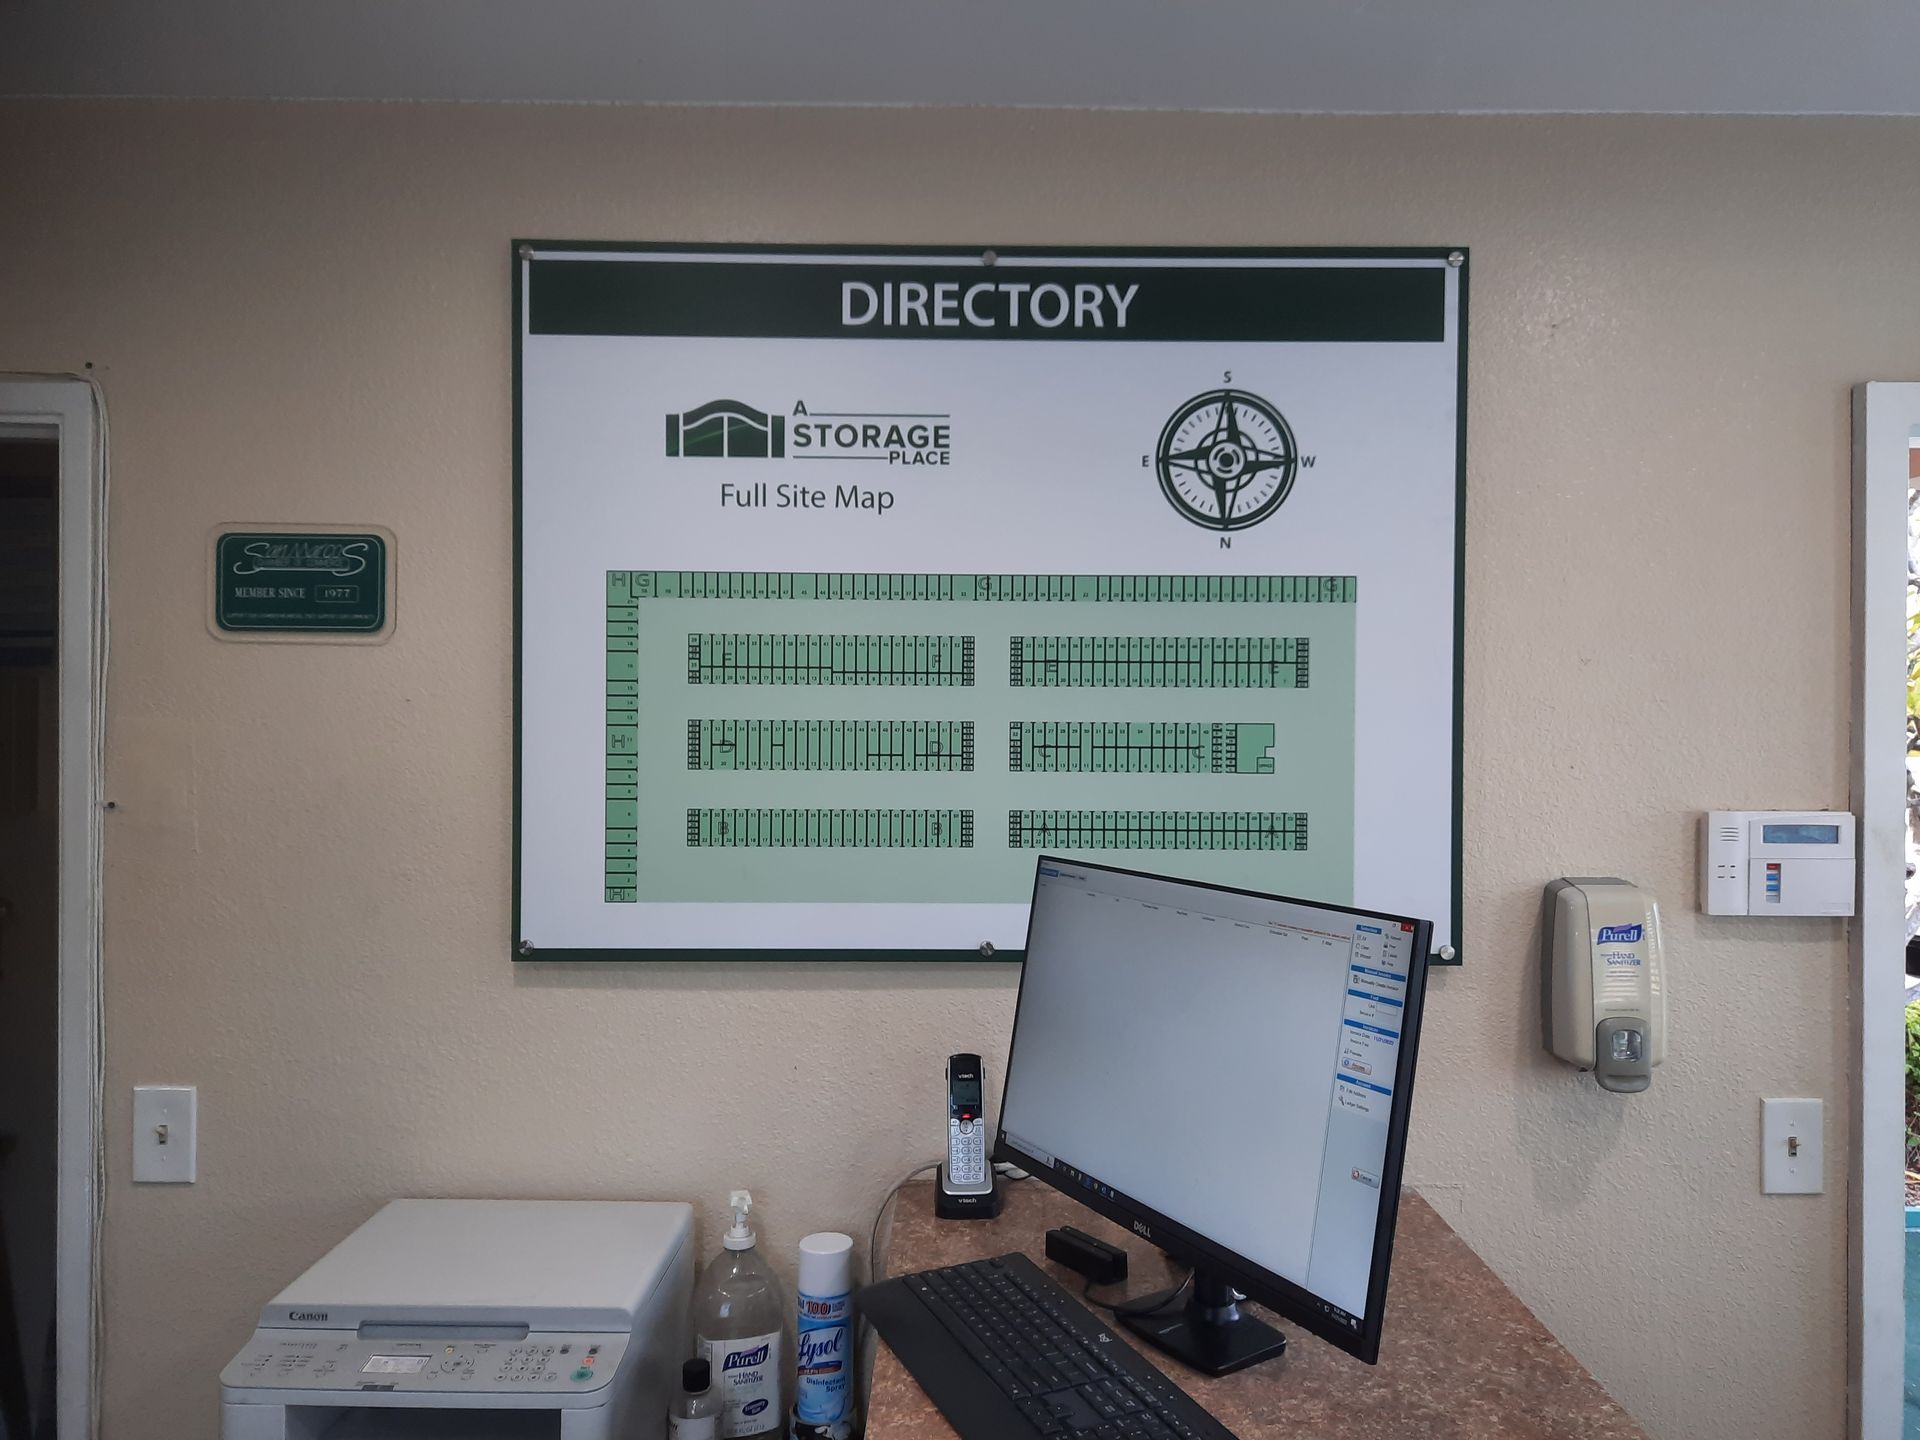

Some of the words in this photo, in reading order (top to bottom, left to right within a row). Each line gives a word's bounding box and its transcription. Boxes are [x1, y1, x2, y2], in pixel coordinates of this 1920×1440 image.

[842, 282, 1139, 327] DIRECTORY
[1224, 371, 1232, 383] S
[793, 400, 808, 416] A
[793, 423, 951, 449] STORAGE
[889, 450, 951, 465] PLACE
[1142, 455, 1149, 467] E
[1301, 456, 1316, 468] W
[721, 483, 766, 508] Full
[777, 483, 826, 508] Site
[836, 484, 895, 514] Map
[1220, 537, 1231, 549] N
[612, 573, 626, 586] H
[635, 573, 650, 587] G
[978, 577, 992, 591] G
[235, 587, 276, 598] MEMBER
[278, 588, 305, 598] SINCE
[324, 588, 350, 598] 1977
[611, 734, 626, 748] H
[930, 741, 944, 755] D
[610, 888, 625, 901] H
[1602, 928, 1638, 941] Purell
[1607, 958, 1641, 966] SANITIZER
[1612, 951, 1635, 959] HAND
[1133, 1219, 1151, 1238] DELL
[289, 1311, 328, 1321] Canon
[798, 1328, 843, 1366] Lysol
[728, 1350, 764, 1368] Purell
